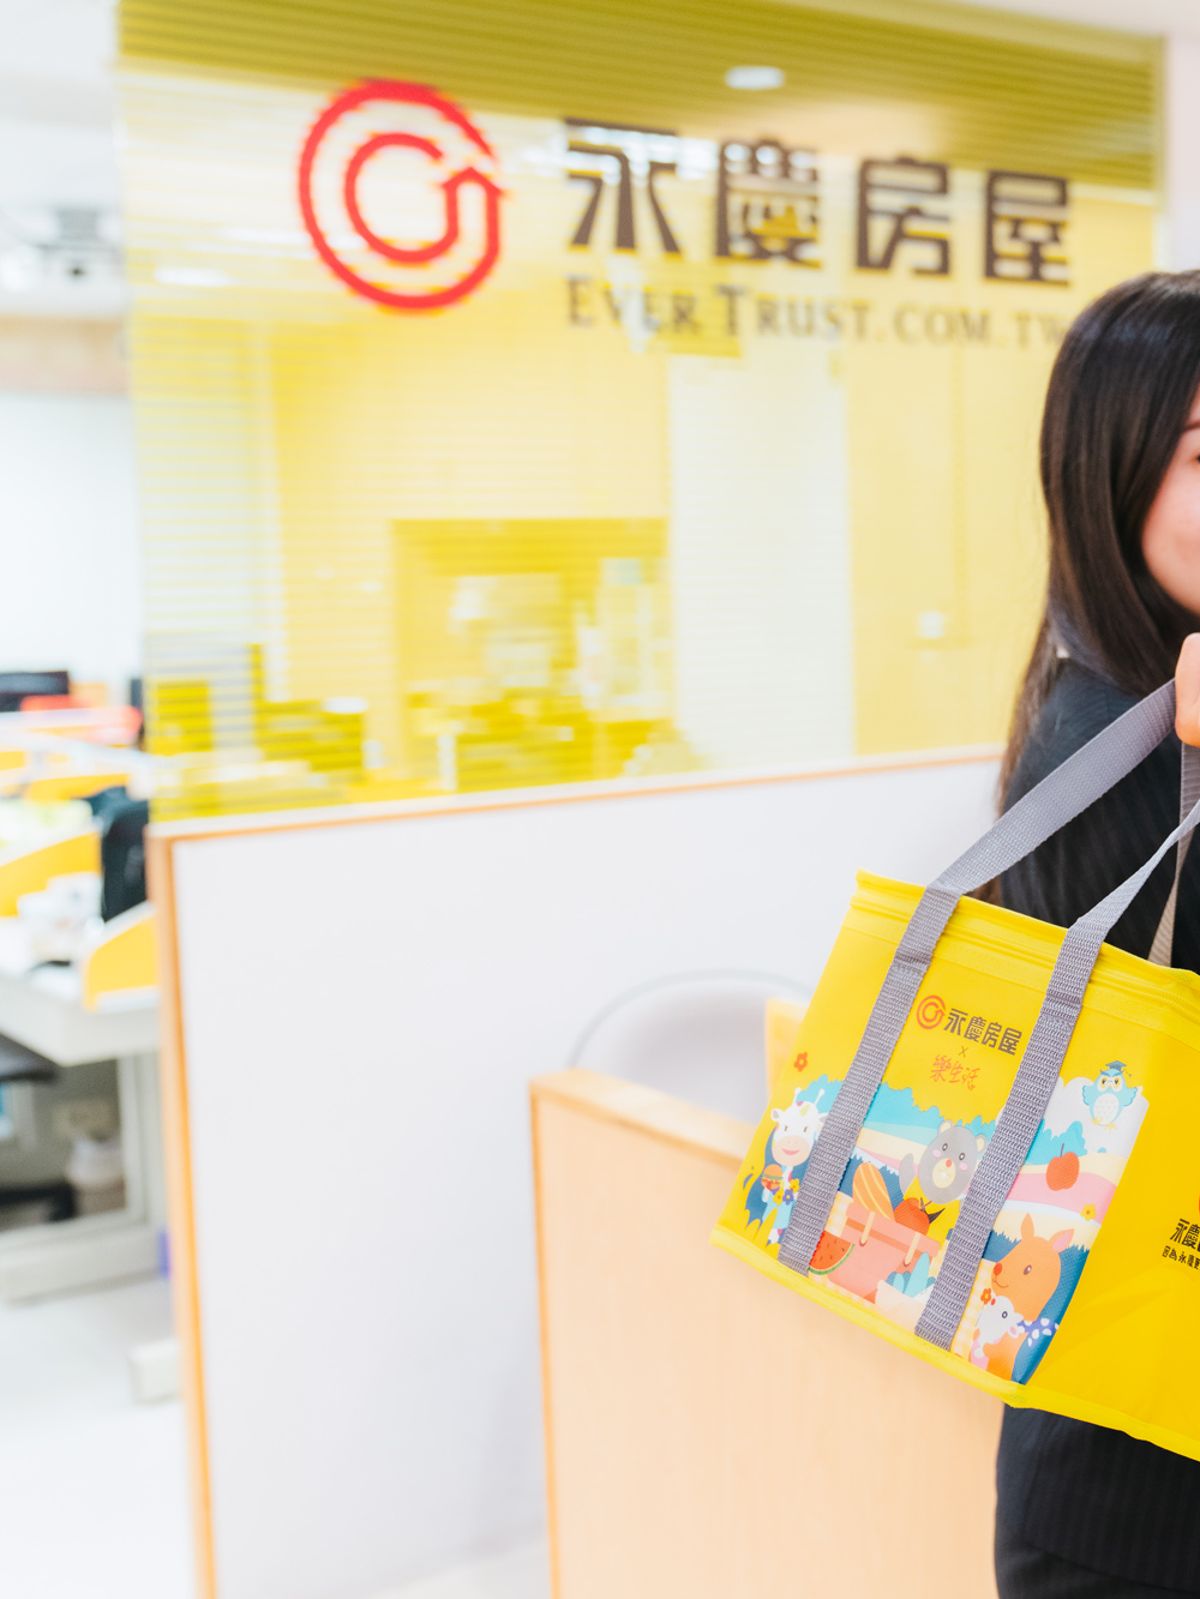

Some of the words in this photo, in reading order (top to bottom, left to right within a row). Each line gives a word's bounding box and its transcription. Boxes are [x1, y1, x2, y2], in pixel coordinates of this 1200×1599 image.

[563, 116, 1070, 286] 永慶房屋
[943, 1007, 1023, 1056] 永慶房屋
[929, 1054, 981, 1091] 樂生活
